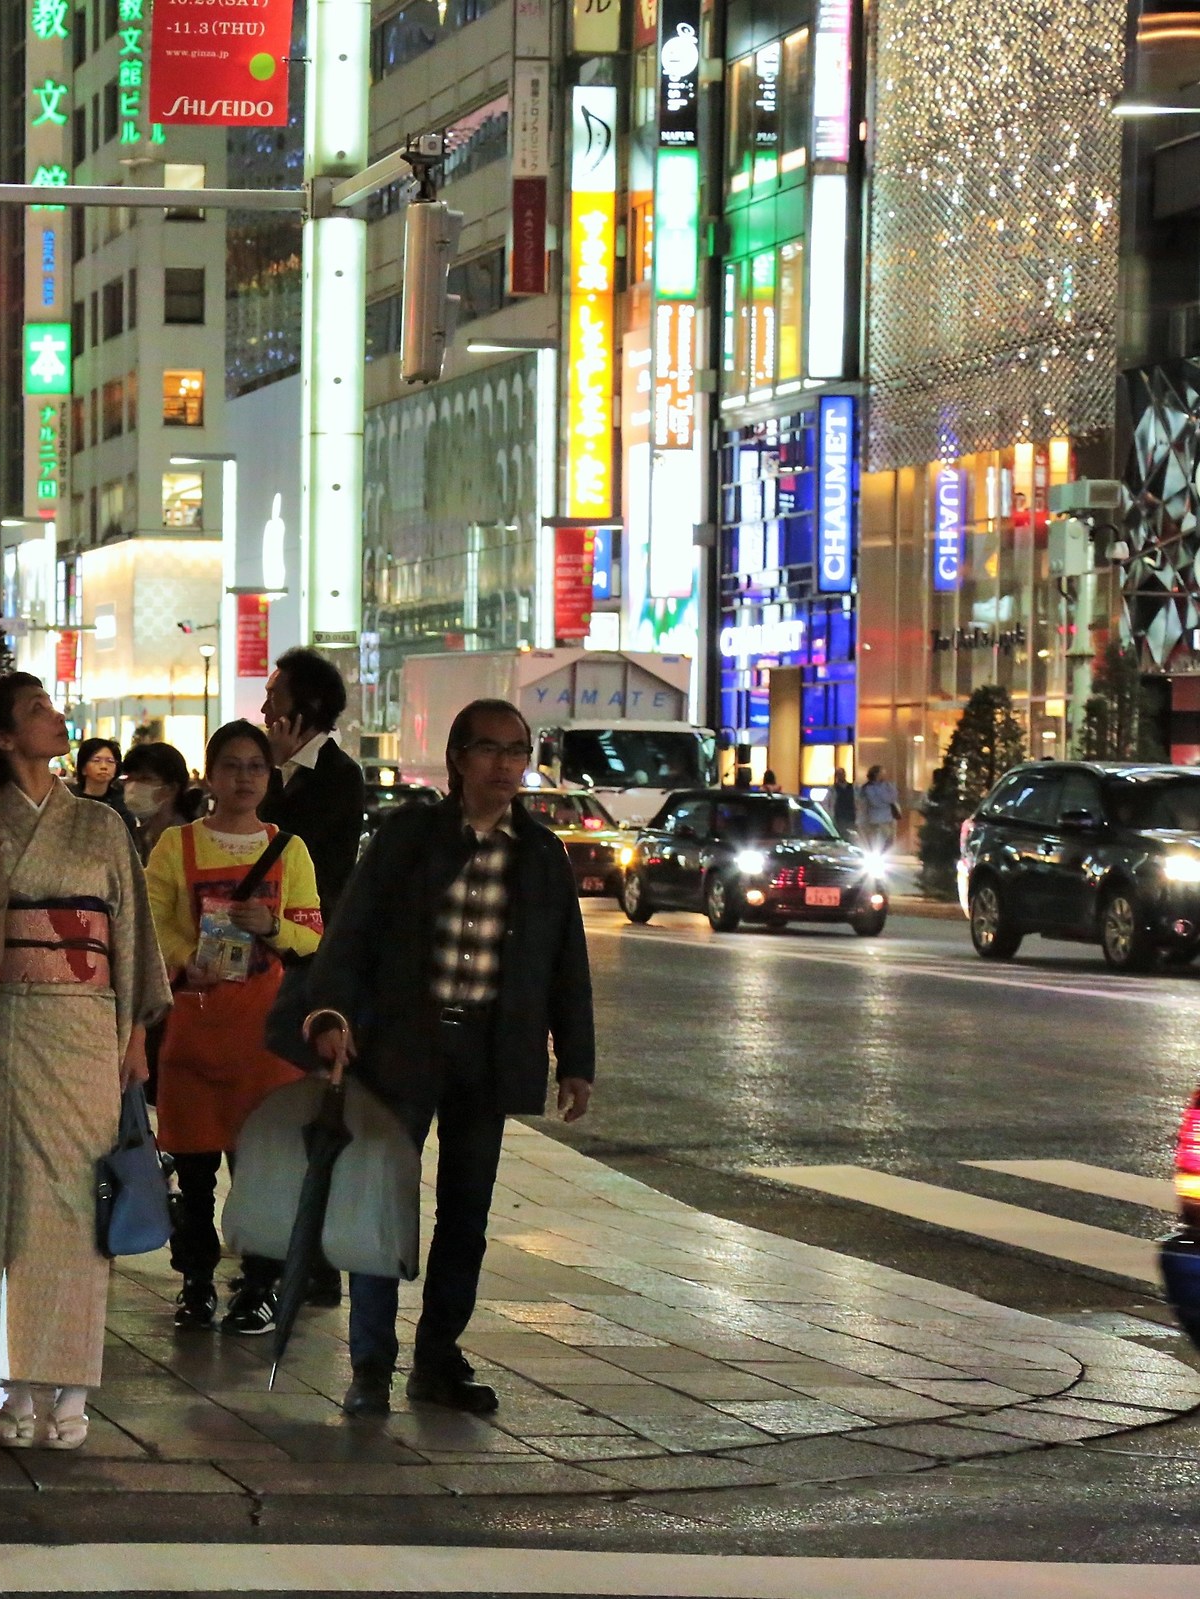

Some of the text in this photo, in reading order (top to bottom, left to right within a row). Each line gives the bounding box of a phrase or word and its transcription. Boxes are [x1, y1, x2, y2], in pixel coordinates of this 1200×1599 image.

[167, 21, 265, 36] -11.3(THU)
[166, 49, 229, 59] www.ginza.jp
[162, 96, 273, 117] SHISEIDO
[30, 334, 66, 384] 本
[824, 409, 847, 581] CHAUMET
[536, 688, 668, 707] YAMATE
